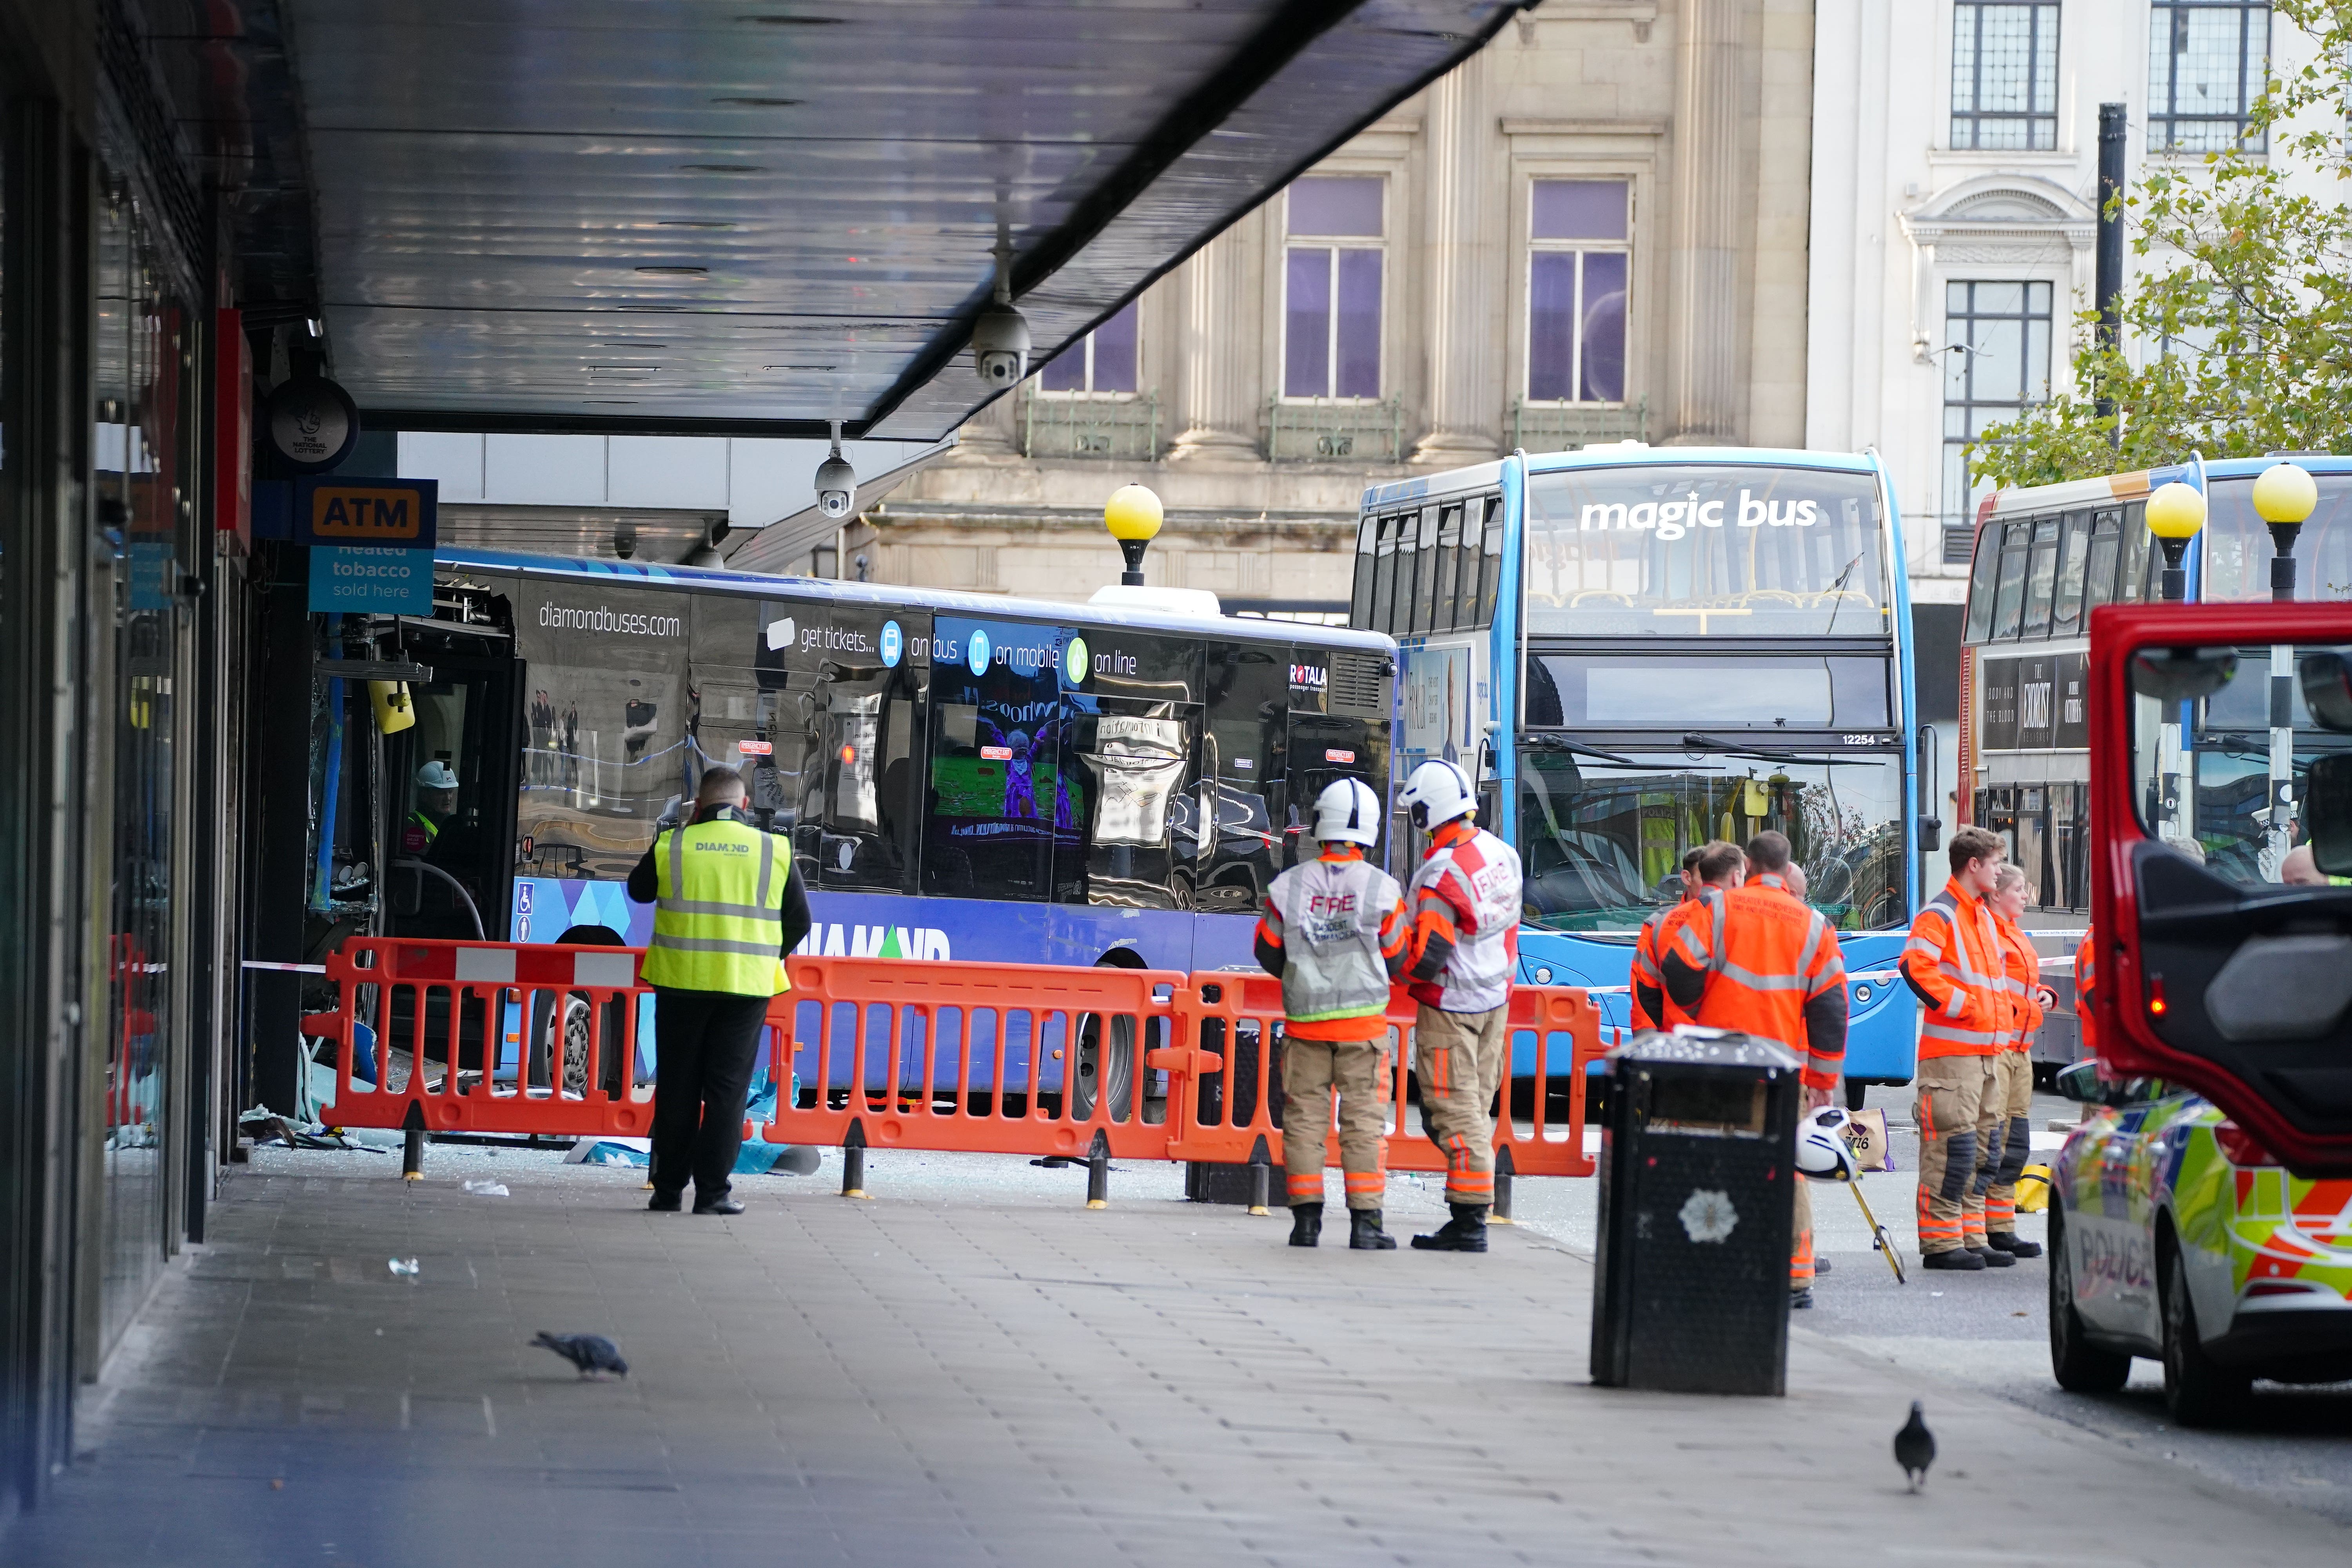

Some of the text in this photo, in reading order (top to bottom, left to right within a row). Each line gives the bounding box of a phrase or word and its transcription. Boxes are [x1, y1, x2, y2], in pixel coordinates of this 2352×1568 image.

[323, 497, 408, 528] ATM
[1580, 488, 1817, 541] magic bus
[333, 561, 411, 578] tobacco
[334, 583, 409, 598] sold here
[539, 601, 680, 637] diamondbuses.com
[801, 627, 875, 653] get tickets...
[911, 633, 957, 659] on bus
[996, 643, 1060, 669] on mobile
[1094, 650, 1137, 675] on line
[1989, 686, 2014, 700] BODY AND
[2024, 682, 2051, 728] EXORCIST
[1987, 710, 2014, 723] THE BLOOD
[1842, 735, 1875, 745] 12254
[695, 842, 749, 853] DIAMND
[1310, 895, 1356, 915] FIRE
[1733, 894, 1804, 918] GREATER MANCHESTER
[1846, 1123, 1854, 1136] I
[2079, 1225, 2152, 1289] POLICE
